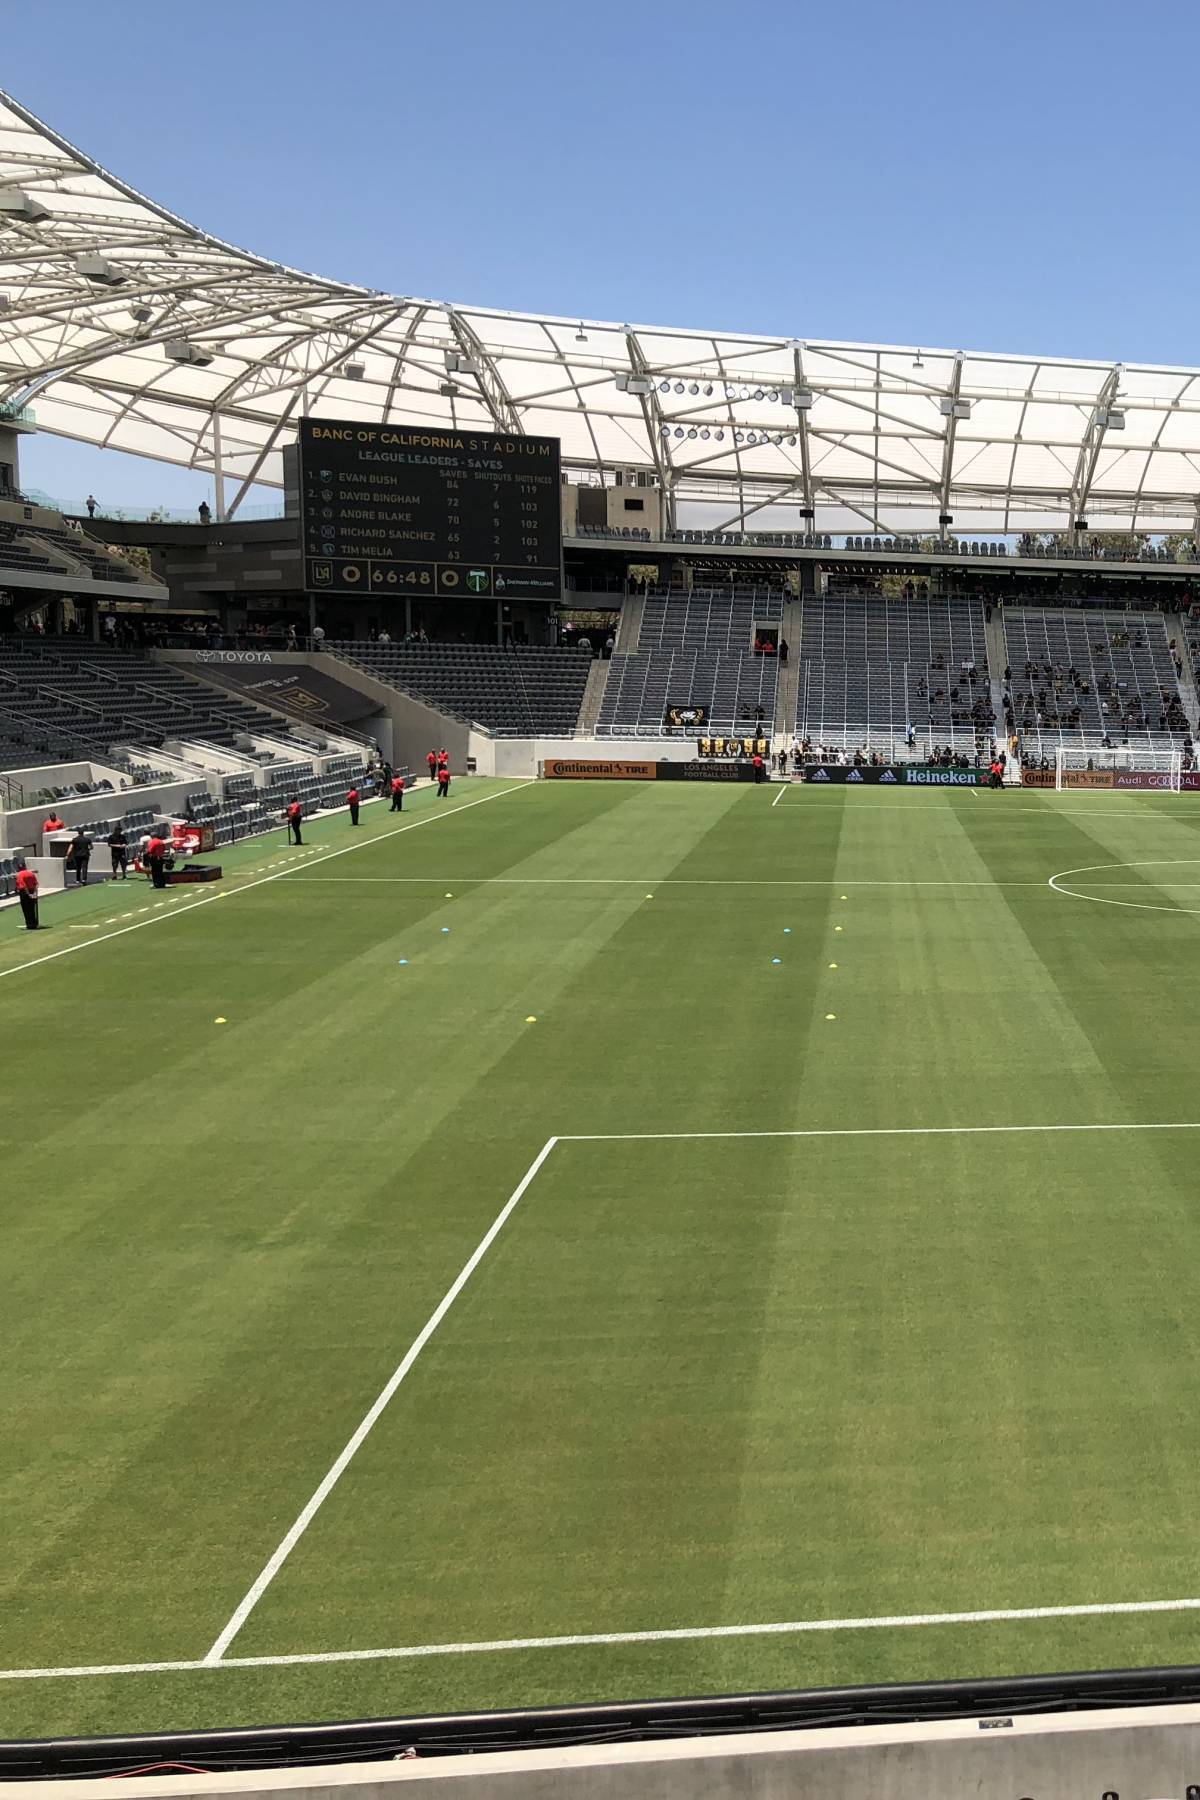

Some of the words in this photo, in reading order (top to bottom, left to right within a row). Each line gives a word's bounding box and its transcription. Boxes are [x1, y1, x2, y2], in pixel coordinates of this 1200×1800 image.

[312, 427, 353, 441] BANC
[357, 431, 377, 442] OF
[380, 433, 464, 449] CALIFORNIA
[469, 440, 550, 456] STADIUM
[359, 450, 405, 463] LEAGUE
[408, 454, 458, 466] LEADERS
[467, 458, 503, 470] SAVES
[339, 472, 367, 483] EVAN
[369, 474, 398, 485] BUSH
[493, 484, 499, 492] 7
[521, 485, 537, 494] 119
[440, 468, 468, 479] SAVES
[474, 471, 512, 482] SHUTOUTS
[340, 491, 371, 501] DAVID
[373, 494, 421, 505] BINGHAM
[447, 498, 459, 507] 72
[493, 501, 500, 510] 6
[521, 502, 537, 512] 103
[340, 509, 376, 520] ANDRE
[377, 511, 412, 522] BLAKE
[448, 515, 460, 525] 70
[494, 518, 500, 527] 5
[521, 520, 538, 529] 102
[340, 527, 386, 538] RICHARD
[388, 530, 436, 541] SANCHEZ
[447, 533, 460, 542] 65
[494, 535, 500, 544] 2
[521, 537, 538, 546] 103
[341, 544, 359, 555] TIM
[361, 546, 393, 557] MELIA
[448, 551, 460, 560] 63
[526, 554, 538, 564] 91
[372, 569, 431, 585] 66:48
[219, 652, 272, 663] TOYOTA
[552, 761, 614, 776] Continental
[625, 765, 649, 775] TIRE
[684, 763, 700, 771] LOS
[701, 764, 739, 772] ANGELES
[684, 771, 720, 779] FOOTBALL
[906, 769, 976, 784] Heineken
[1117, 776, 1142, 785] Audi
